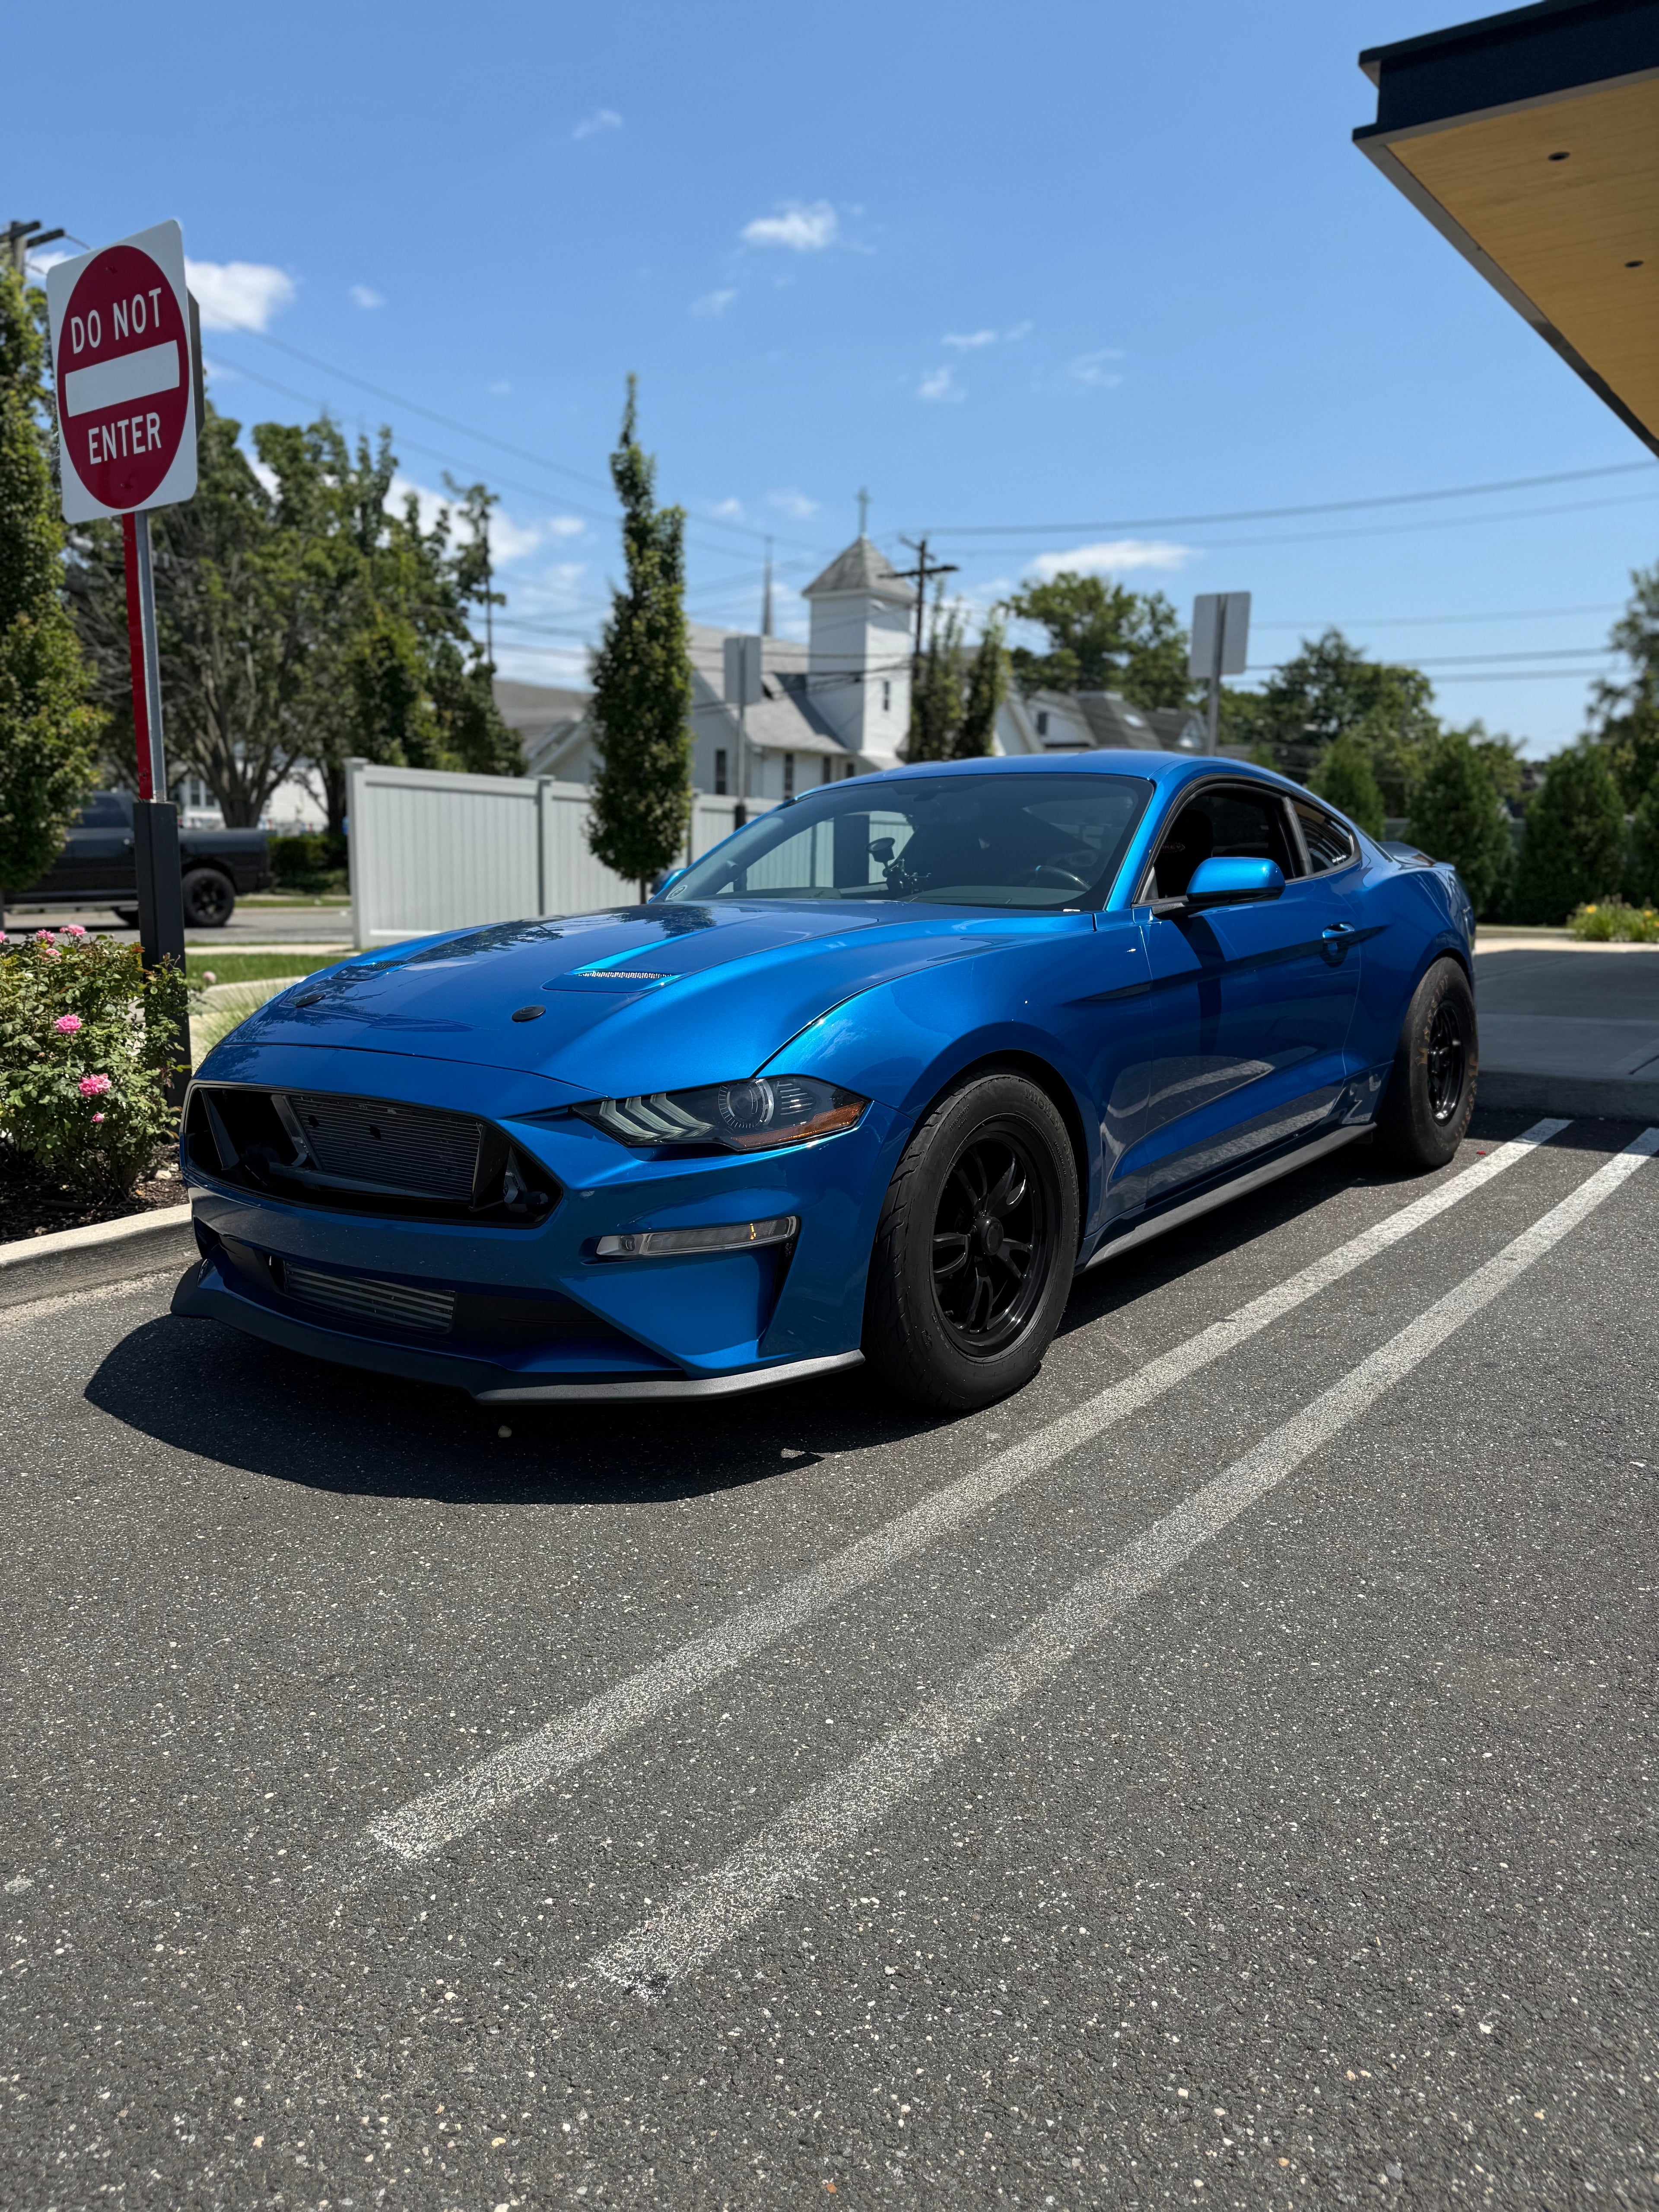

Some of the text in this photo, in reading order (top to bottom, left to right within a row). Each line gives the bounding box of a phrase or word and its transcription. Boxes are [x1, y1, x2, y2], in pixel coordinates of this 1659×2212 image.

[71, 287, 162, 354] DO NOT
[88, 412, 162, 465] ENTER
[1023, 1087, 1061, 1131] MICKEY
